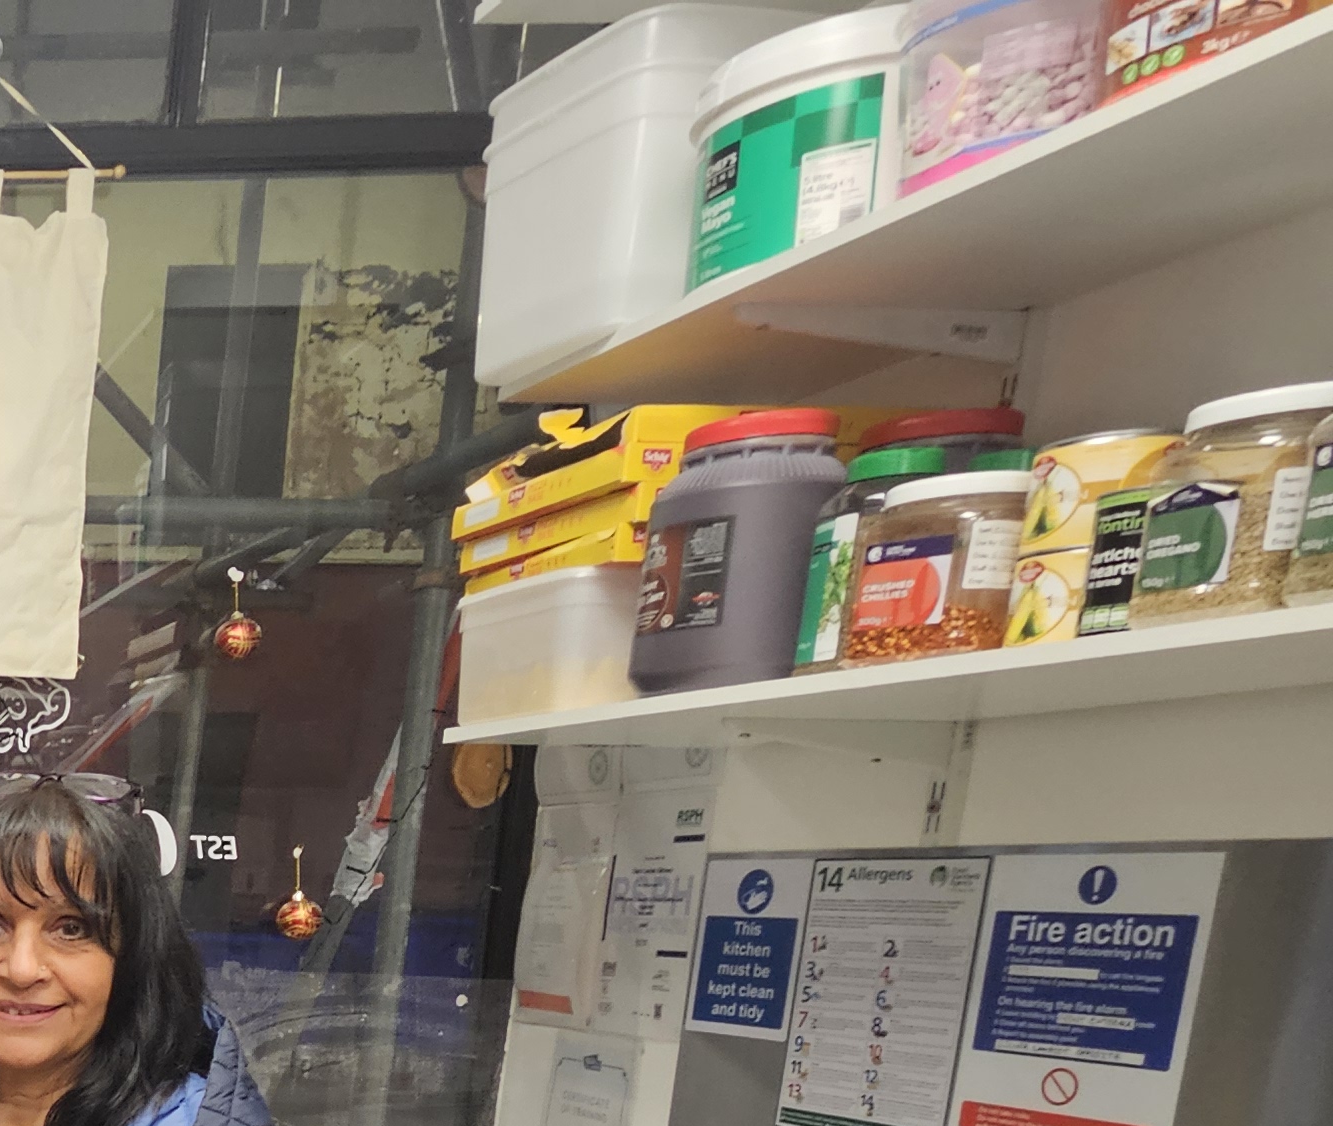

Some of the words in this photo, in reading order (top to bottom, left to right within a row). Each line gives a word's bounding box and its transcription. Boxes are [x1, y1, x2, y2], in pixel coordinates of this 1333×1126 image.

[817, 866, 844, 893] 14
[847, 866, 915, 885] Allergens
[733, 920, 762, 937] This
[1008, 914, 1067, 943] Fire
[1073, 917, 1176, 948] action
[721, 941, 772, 958] kitchen
[717, 962, 751, 977] must
[752, 964, 771, 979] be
[707, 980, 736, 999] kept
[738, 984, 775, 1000] clean
[710, 1003, 736, 1017] and
[738, 1003, 765, 1023] tidy
